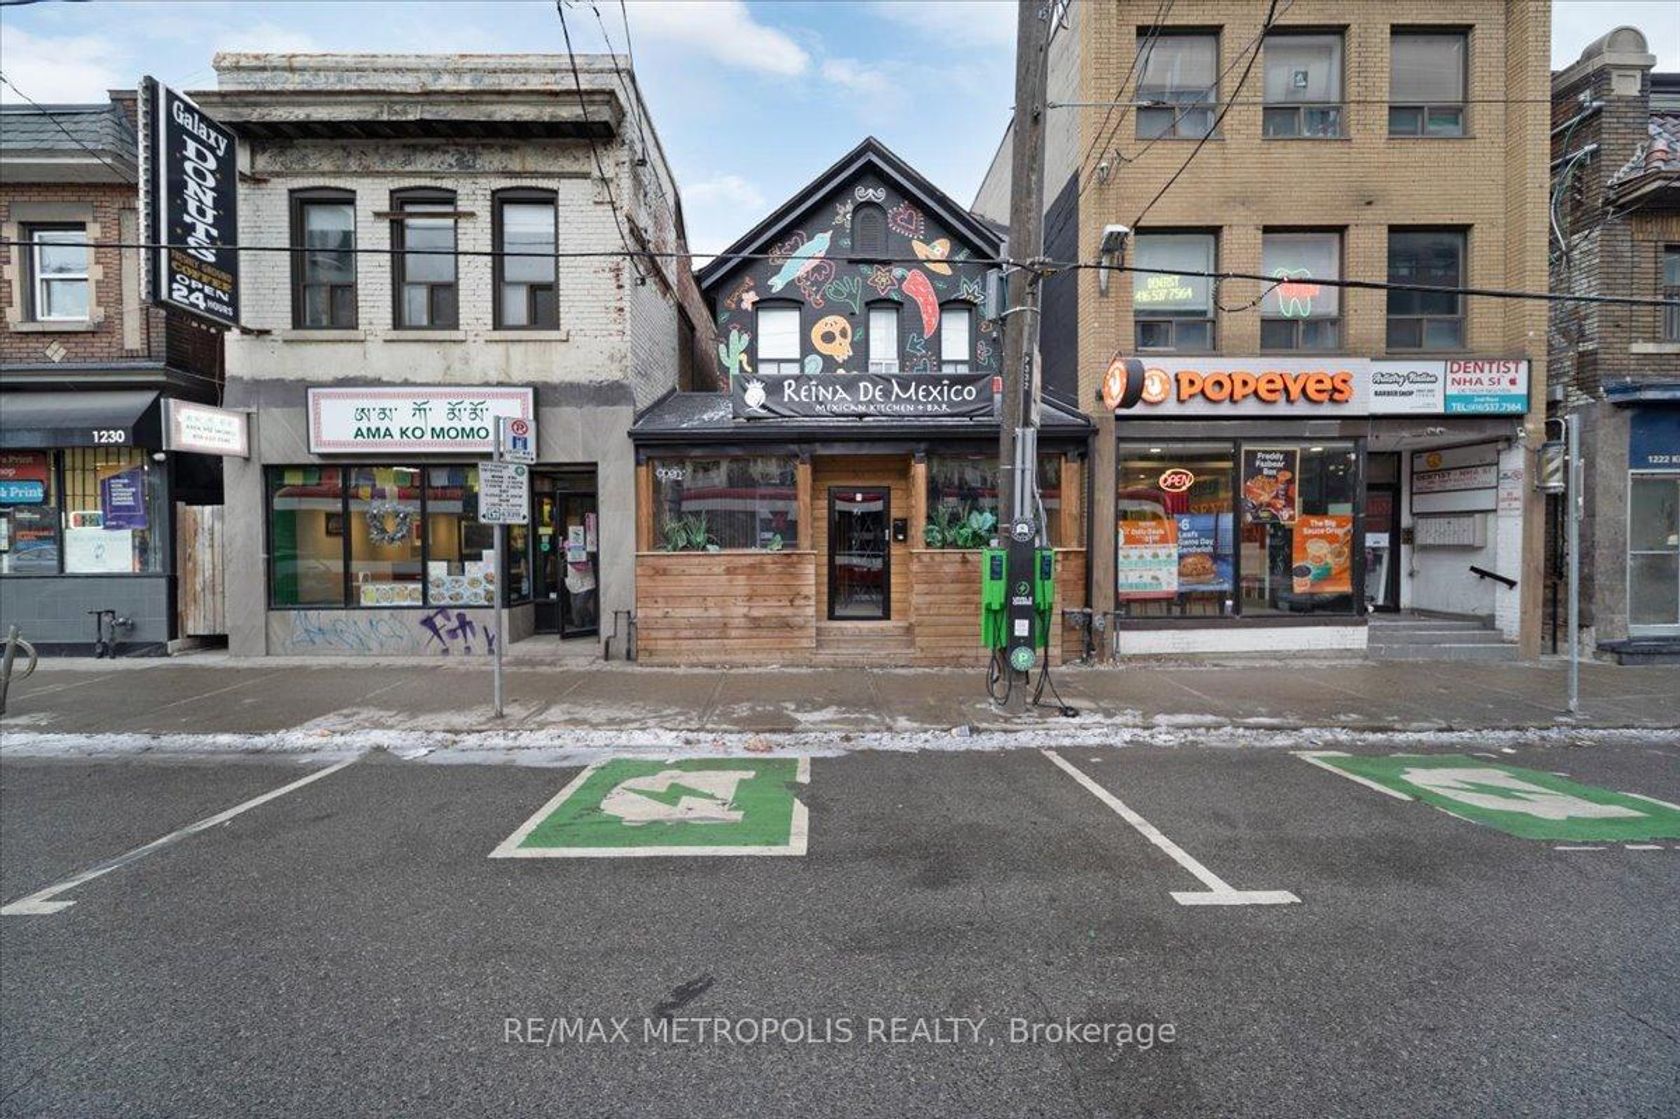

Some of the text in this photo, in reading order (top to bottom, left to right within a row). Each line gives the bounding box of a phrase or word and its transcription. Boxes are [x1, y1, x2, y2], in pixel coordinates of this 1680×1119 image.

[172, 99, 228, 158] Galaxy
[182, 134, 219, 264] DONUTS
[176, 273, 229, 302] OPEN
[172, 282, 206, 310] 24
[1450, 361, 1522, 374] DENTIST
[1451, 376, 1484, 386] NHA
[815, 403, 868, 412] MEXICAN
[869, 403, 915, 412] KITCHEN
[926, 403, 951, 412] BAR
[92, 430, 125, 443] 1230
[353, 426, 490, 440] AMA KO MOMO
[1648, 455, 1670, 463] 1222
[1162, 473, 1190, 487] OPEN
[9, 484, 44, 497] Print
